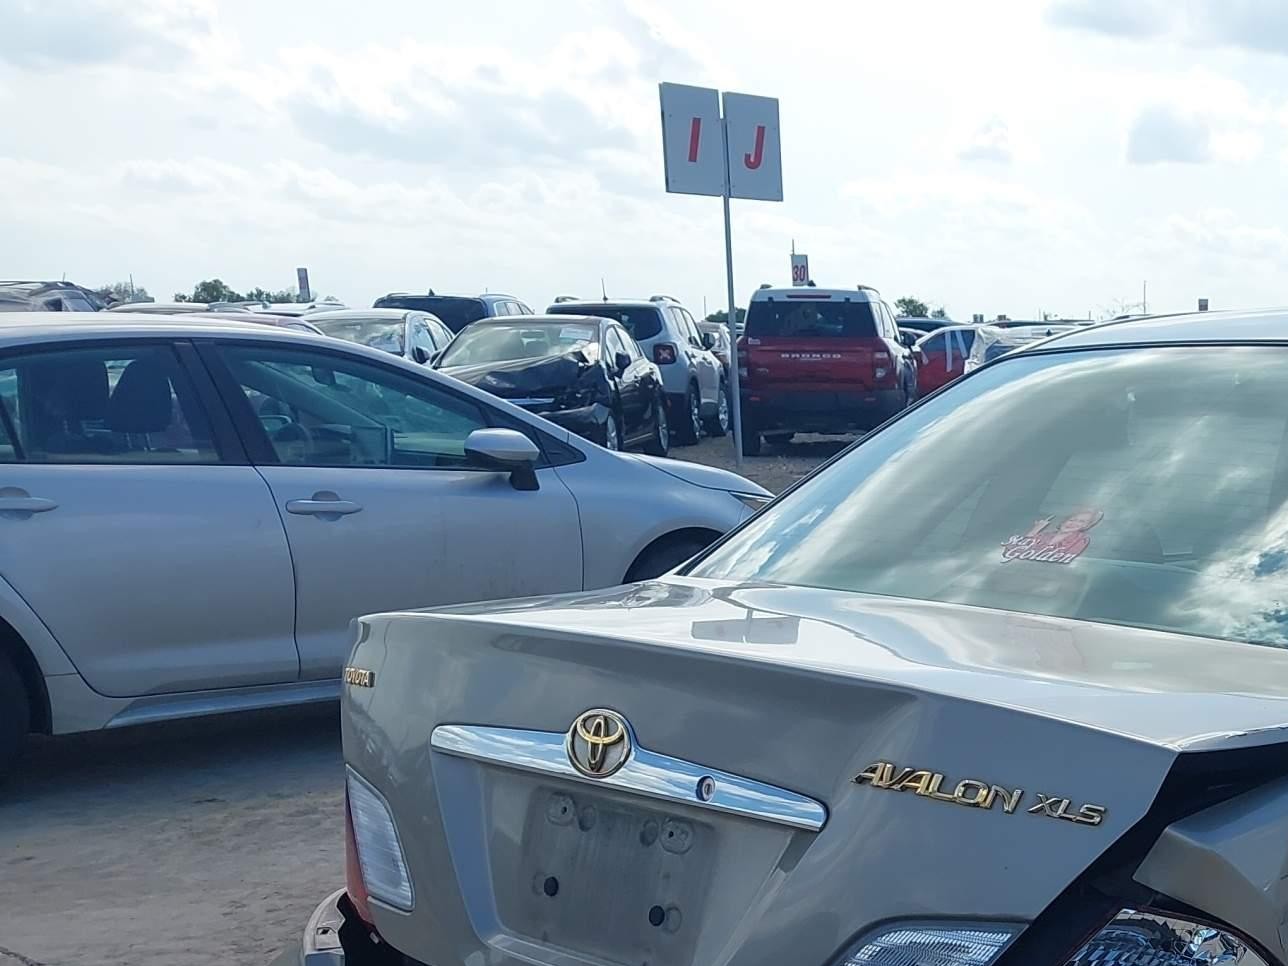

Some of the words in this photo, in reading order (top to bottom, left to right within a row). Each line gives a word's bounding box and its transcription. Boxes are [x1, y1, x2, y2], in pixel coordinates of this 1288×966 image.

[688, 117, 701, 162] I
[744, 126, 765, 169] J
[793, 265, 806, 281] 30
[1001, 545, 1076, 563] Golden
[851, 762, 1024, 814] AVALON
[1027, 793, 1107, 826] XLS
